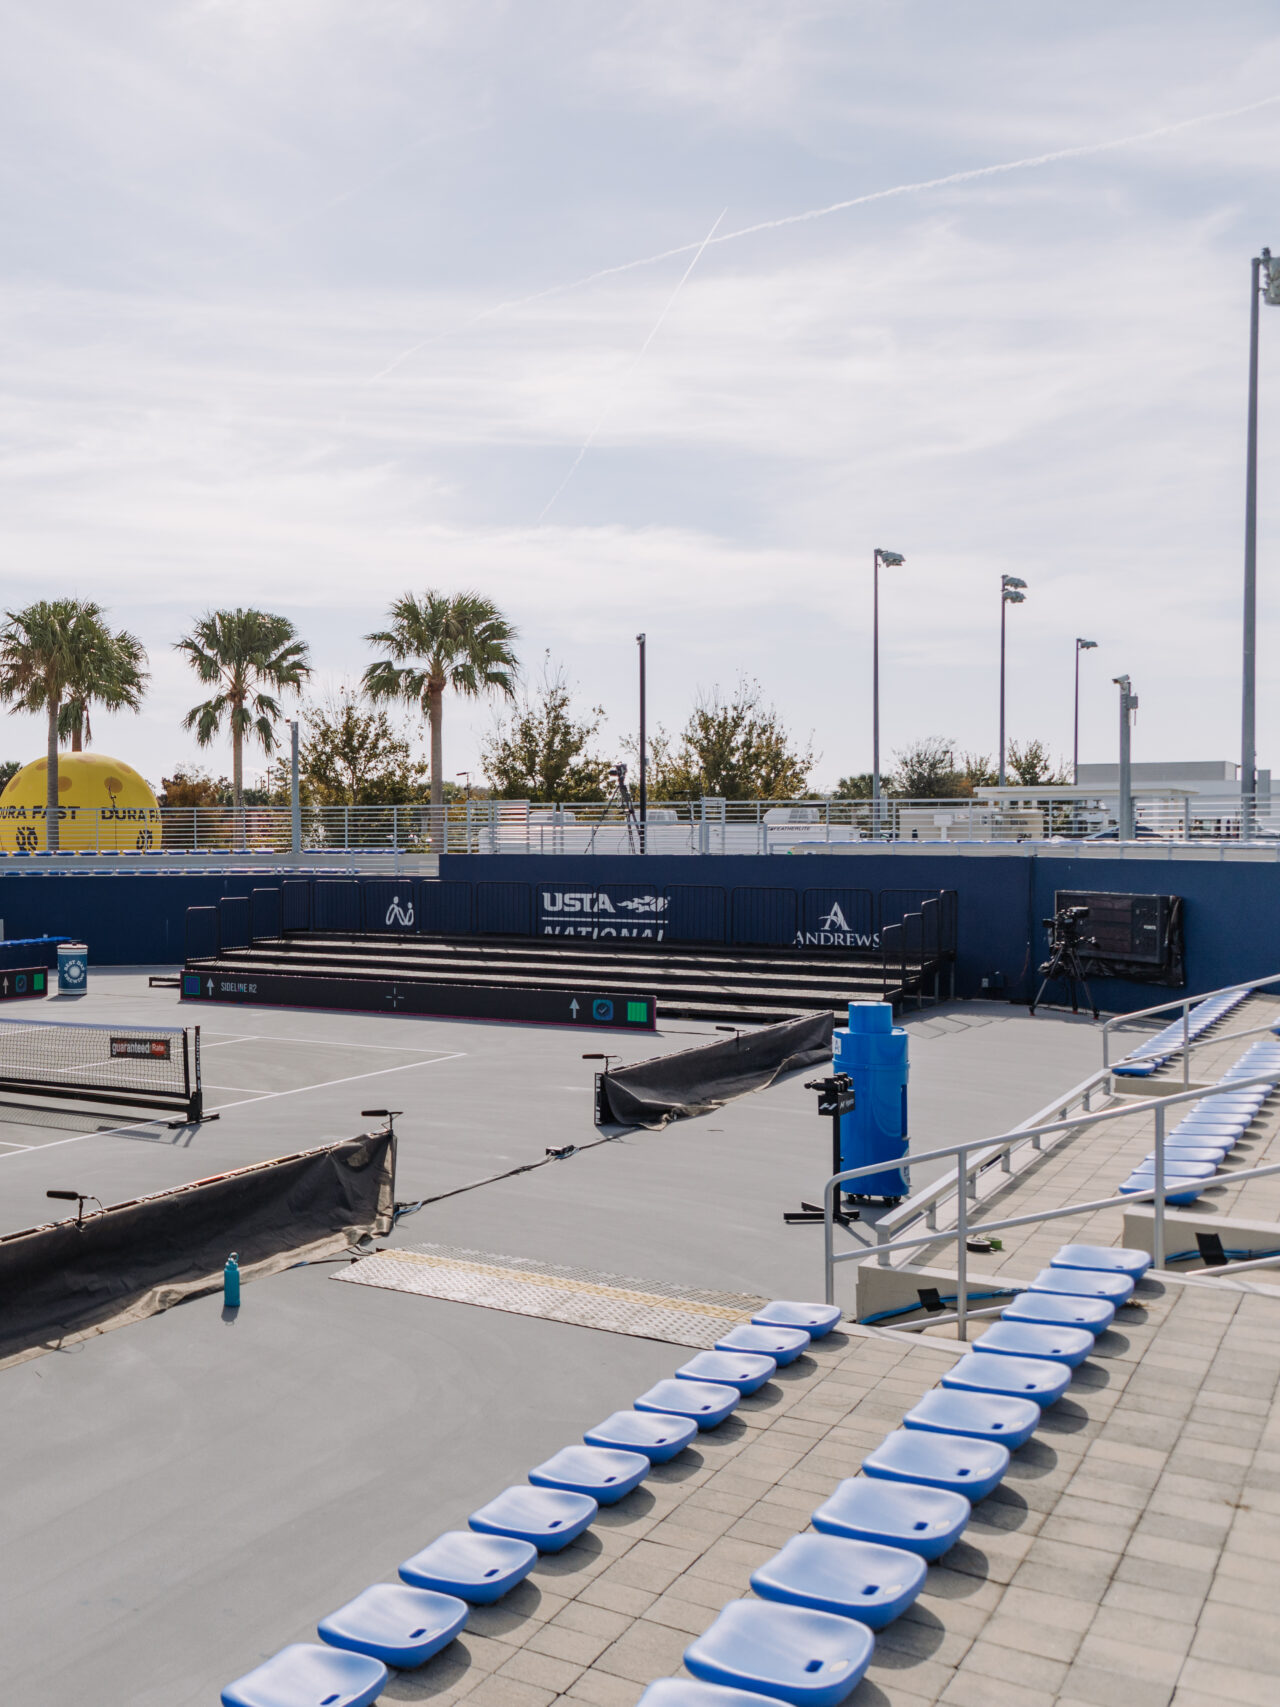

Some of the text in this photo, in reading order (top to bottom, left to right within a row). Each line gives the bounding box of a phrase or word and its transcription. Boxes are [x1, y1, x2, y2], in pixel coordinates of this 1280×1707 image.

[101, 807, 146, 821] DURA
[542, 892, 616, 913] USTA
[792, 930, 880, 948] ANDREWS
[220, 982, 258, 994] SIDELINE R2
[112, 1042, 165, 1056] guaranteed Rate
